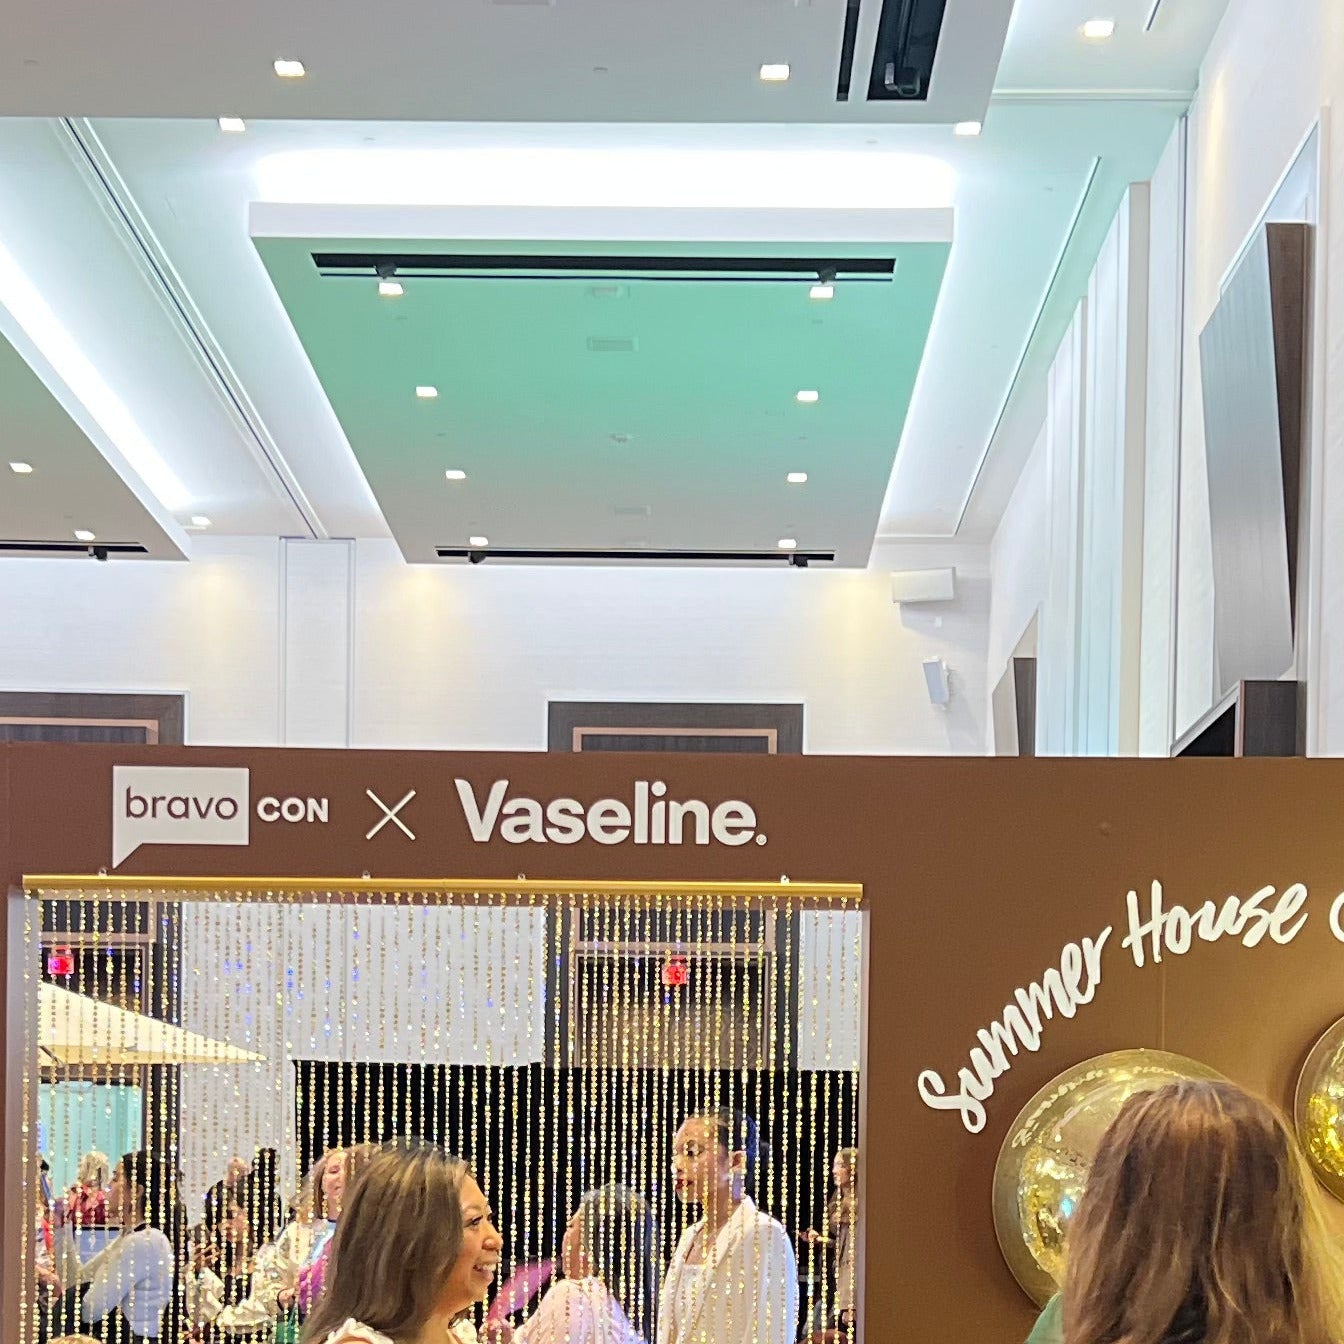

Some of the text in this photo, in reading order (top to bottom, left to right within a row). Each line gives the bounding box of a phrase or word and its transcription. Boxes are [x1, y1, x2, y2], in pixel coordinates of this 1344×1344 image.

[125, 785, 239, 820] bravo
[256, 796, 330, 823] CON
[917, 925, 1113, 1134] Summer
[1121, 879, 1309, 968] House
